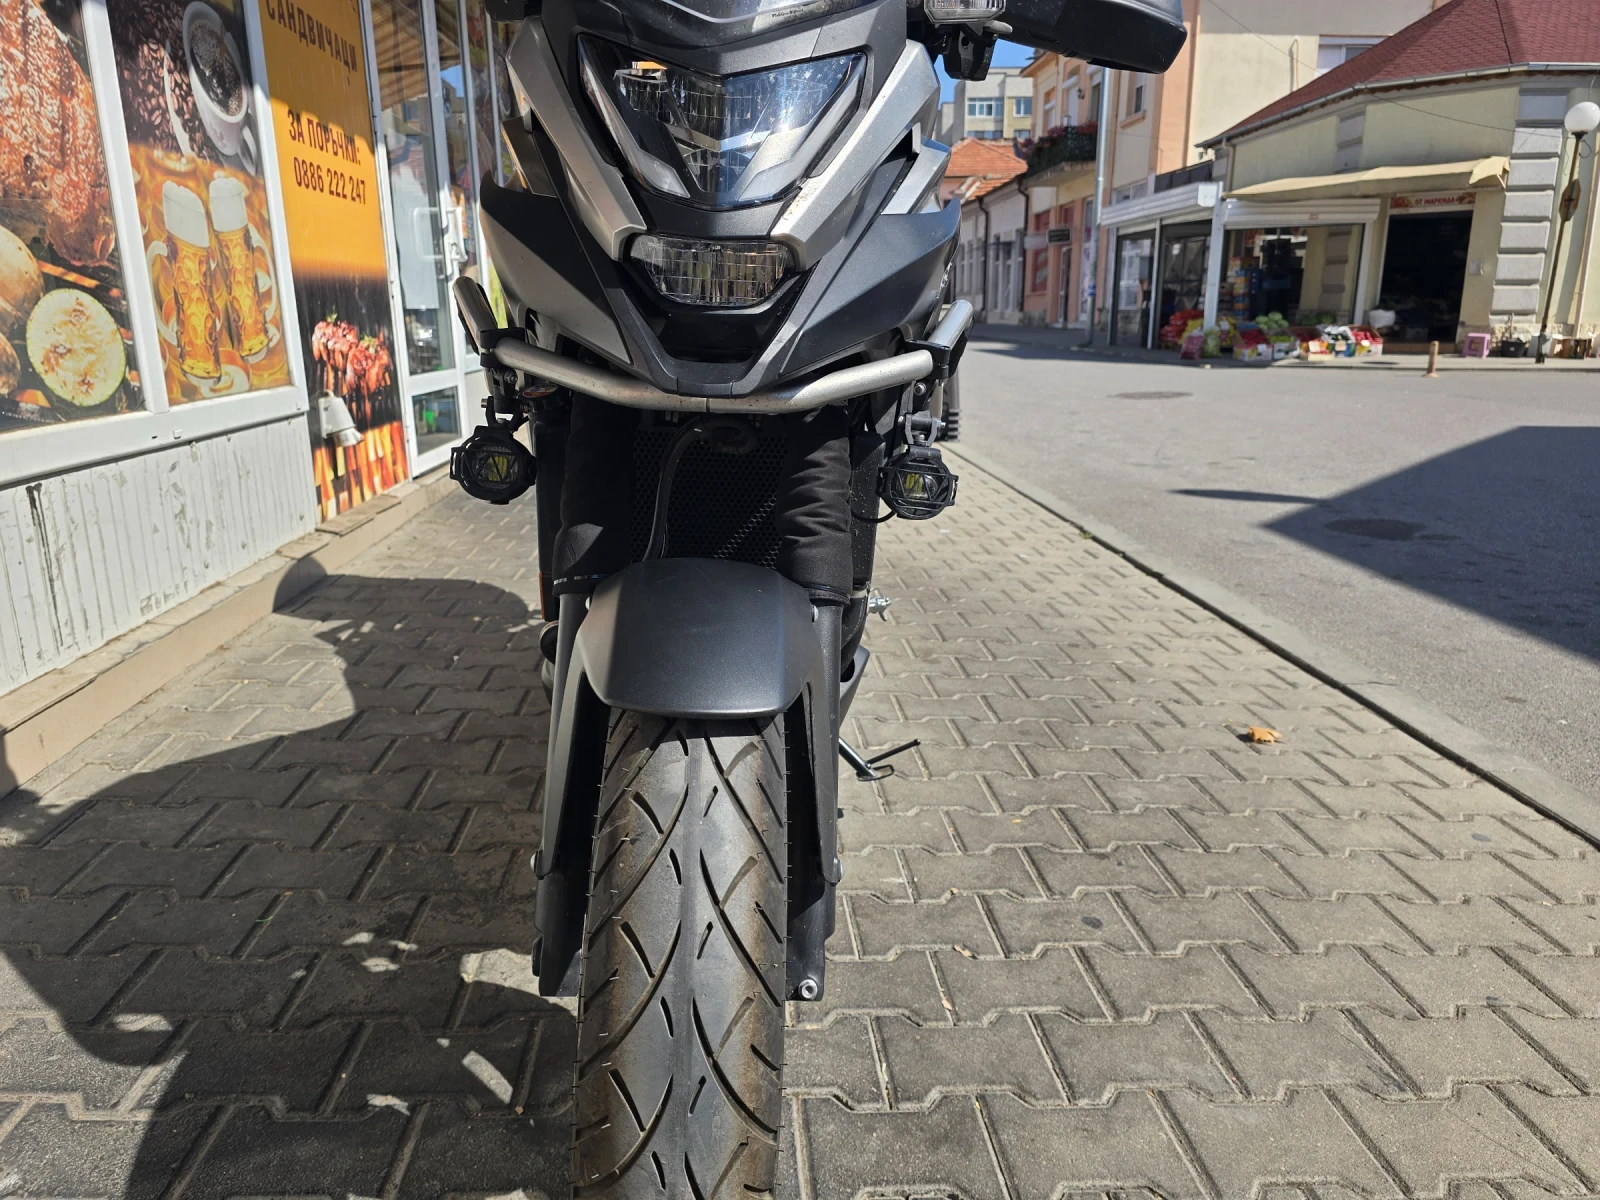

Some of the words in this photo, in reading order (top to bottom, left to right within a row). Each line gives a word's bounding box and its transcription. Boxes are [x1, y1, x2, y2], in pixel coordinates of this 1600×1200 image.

[287, 108, 306, 145] ЗА
[306, 117, 361, 167] ПОРЪЧКИ:
[293, 156, 325, 194] 0886
[326, 167, 348, 200] 222
[348, 175, 366, 206] 247
